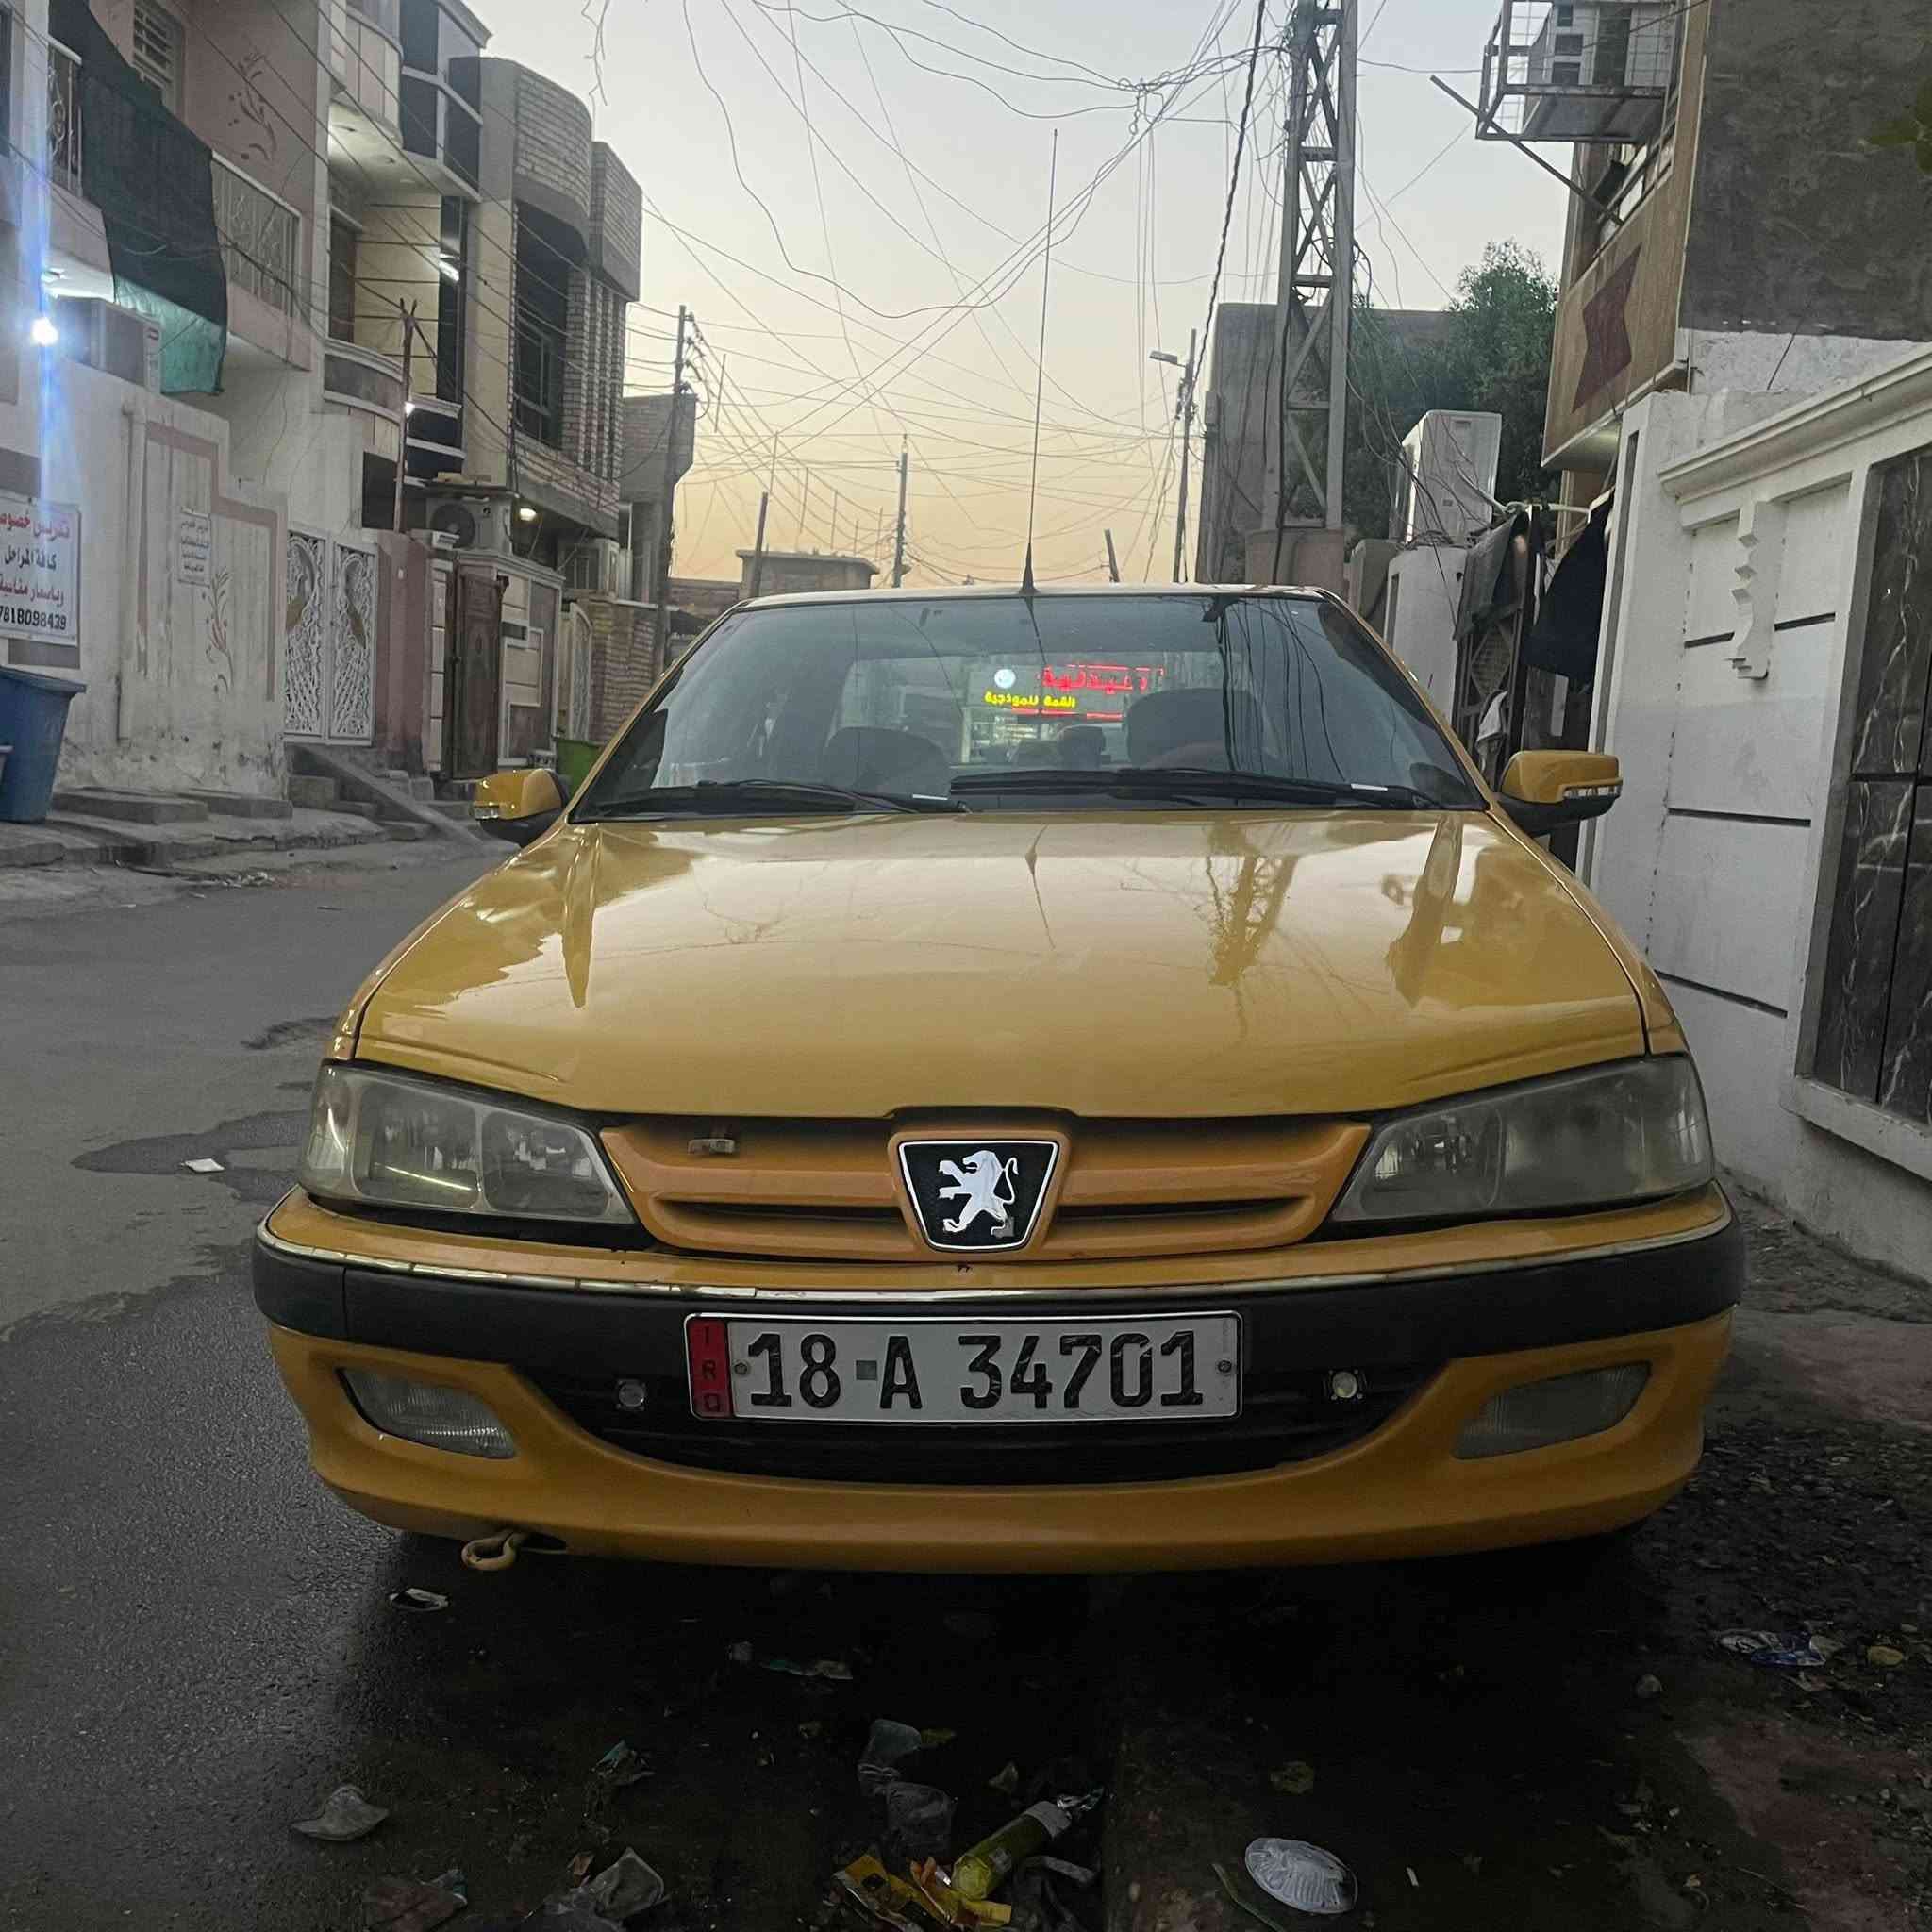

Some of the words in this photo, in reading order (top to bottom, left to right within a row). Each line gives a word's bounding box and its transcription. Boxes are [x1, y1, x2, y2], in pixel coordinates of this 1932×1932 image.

[0, 511, 31, 531] خصوص
[5, 544, 34, 569] المراحل
[36, 548, 57, 571] كافة
[984, 691, 1041, 708] لنموذجية
[747, 1333, 841, 1409] 18
[879, 1335, 923, 1409] A
[958, 1330, 1204, 1409] 34701
